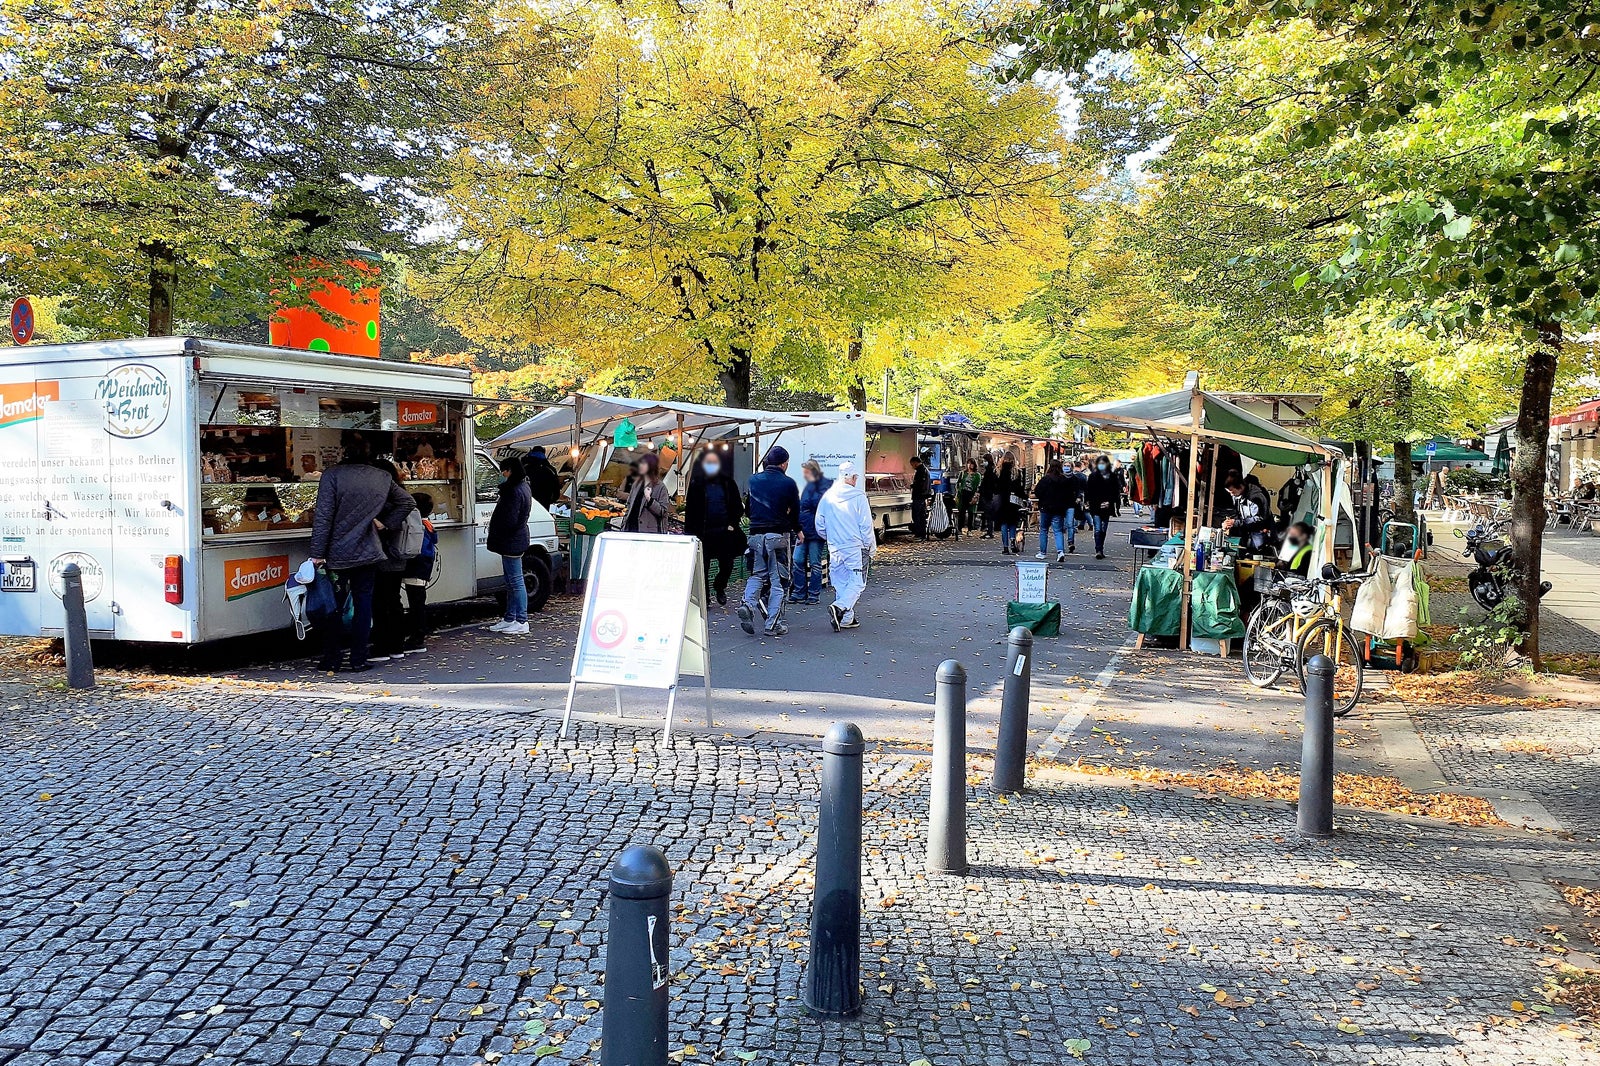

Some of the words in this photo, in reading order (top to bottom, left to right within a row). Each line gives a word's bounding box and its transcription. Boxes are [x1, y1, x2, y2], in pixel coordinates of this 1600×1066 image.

[98, 376, 168, 399] Weichardt
[118, 399, 150, 422] Brot
[402, 408, 432, 422] demeter
[2, 458, 36, 468] veredeln
[70, 457, 104, 466] bekannt
[110, 456, 133, 466] gutes
[138, 455, 176, 465] Berliner
[52, 474, 76, 484] durch
[81, 476, 98, 484] eine
[19, 491, 46, 501] welche
[52, 492, 68, 501] dem
[74, 491, 104, 500] Wasser
[109, 491, 133, 500] einen
[138, 490, 169, 502] großen
[4, 510, 29, 518] seiner
[125, 508, 140, 517] Wir
[3, 526, 31, 536] täglich
[50, 526, 63, 535] der
[68, 526, 112, 536] spontanen
[118, 526, 170, 537] Teiggärung
[3, 576, 14, 586] HW
[16, 576, 31, 586] 912
[231, 564, 282, 589] demeter
